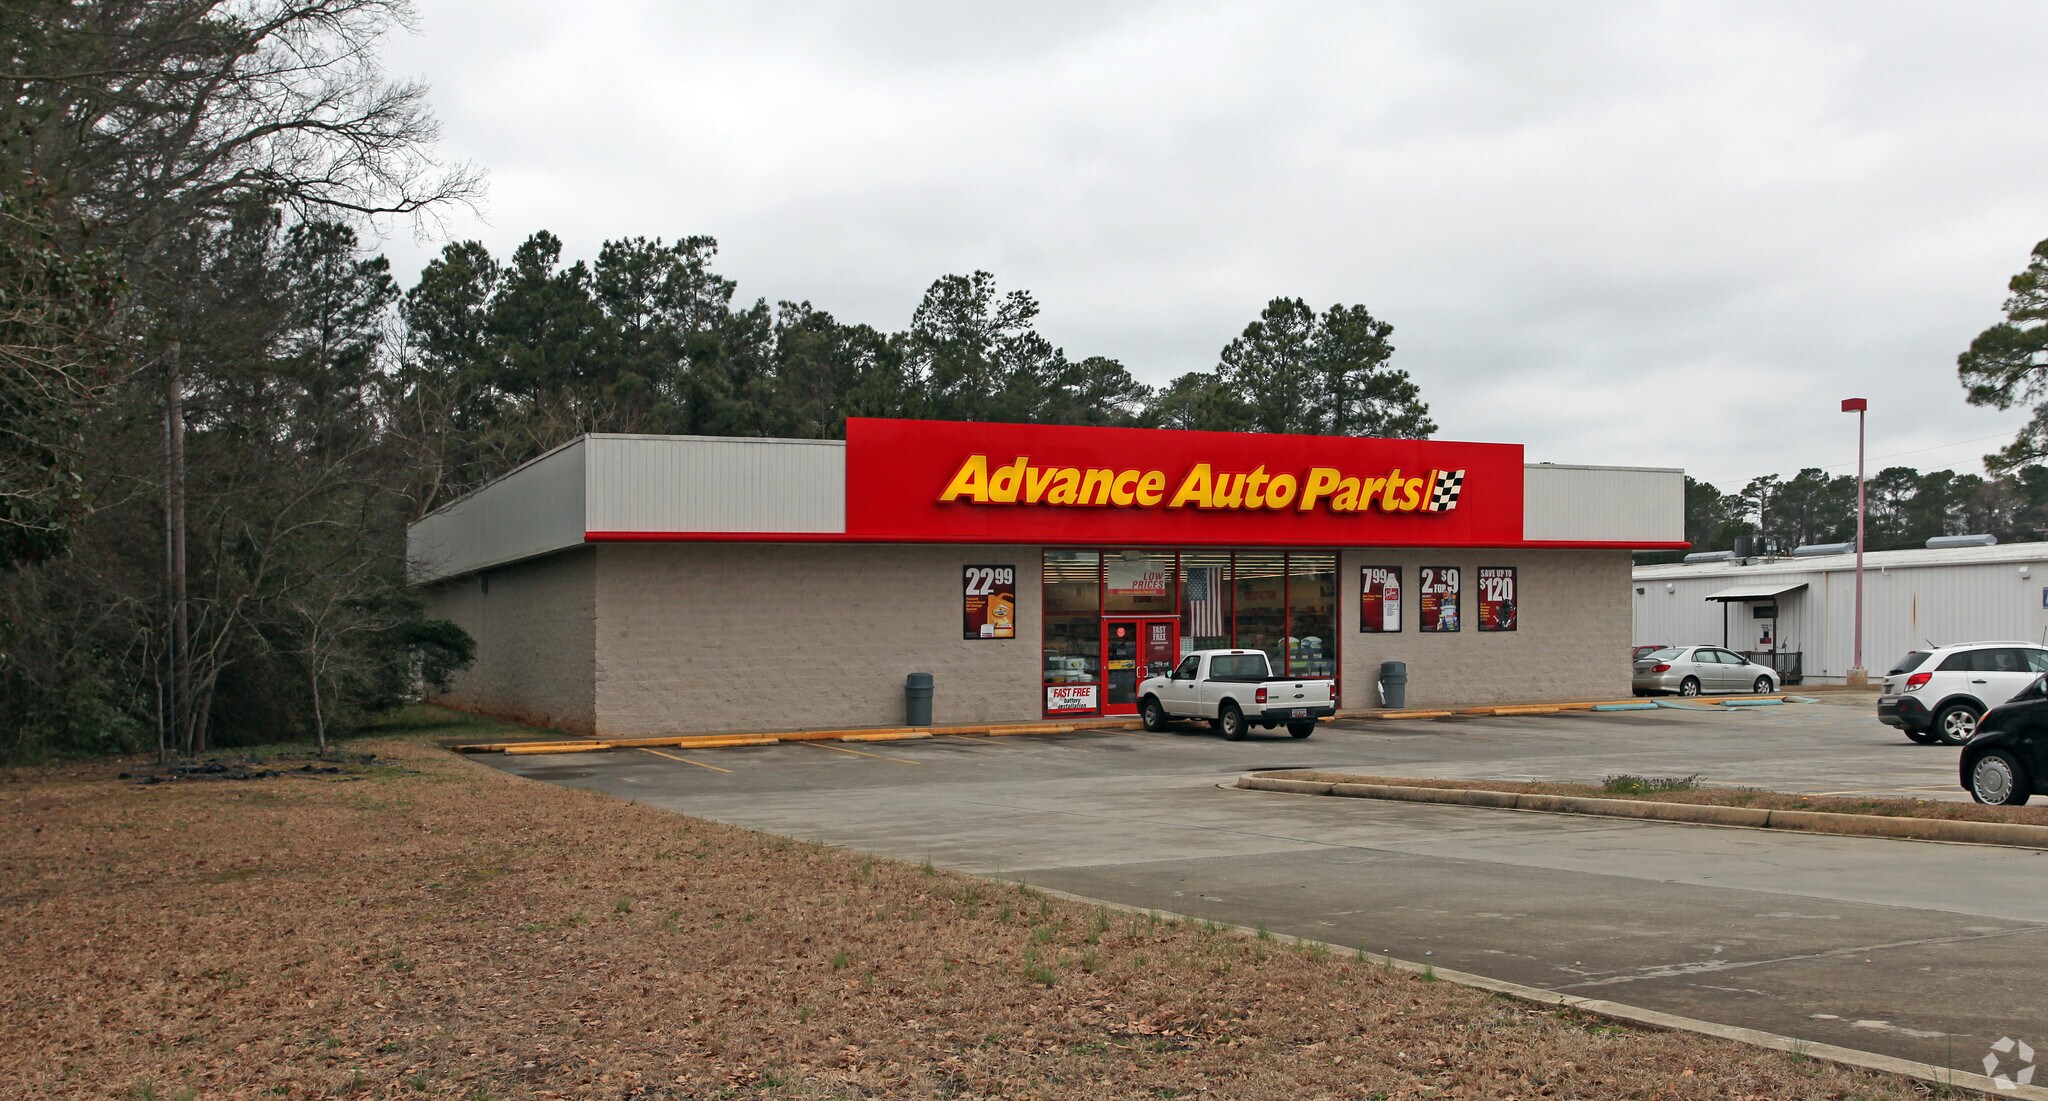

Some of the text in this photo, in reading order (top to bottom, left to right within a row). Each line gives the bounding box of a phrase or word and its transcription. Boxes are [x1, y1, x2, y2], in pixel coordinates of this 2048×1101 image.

[939, 454, 1424, 512] Advance Auto Parts
[1143, 572, 1163, 581] LOW
[1480, 569, 1512, 578] SAVE UP TO
[1132, 580, 1164, 590] PRICES
[1421, 568, 1459, 594] 2 FOR $9
[1480, 577, 1513, 602] $120
[1152, 633, 1166, 641] FREE
[1053, 687, 1091, 697] FAST FREE
